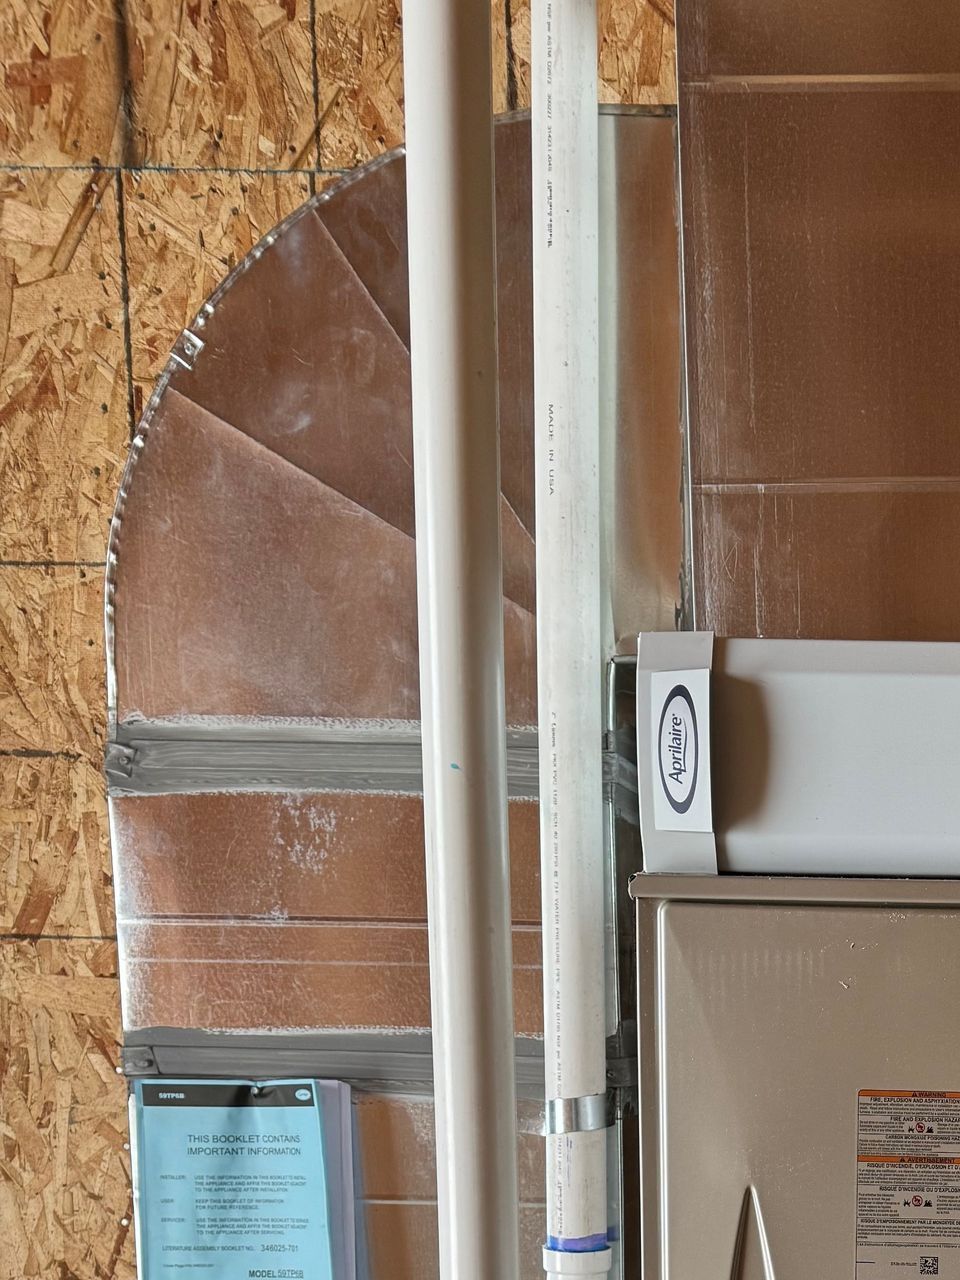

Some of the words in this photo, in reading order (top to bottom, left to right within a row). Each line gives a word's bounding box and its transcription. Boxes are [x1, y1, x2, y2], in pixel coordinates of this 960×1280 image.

[548, 449, 555, 461] IN
[668, 715, 686, 784] Aprilaire
[187, 1134, 210, 1143] THIS
[212, 1134, 260, 1143] BOOKLET
[262, 1134, 301, 1143] CONTAINS
[187, 1147, 245, 1156] IMPORTANT
[247, 1147, 301, 1156] INFORMATION
[249, 1270, 277, 1278] MODEL
